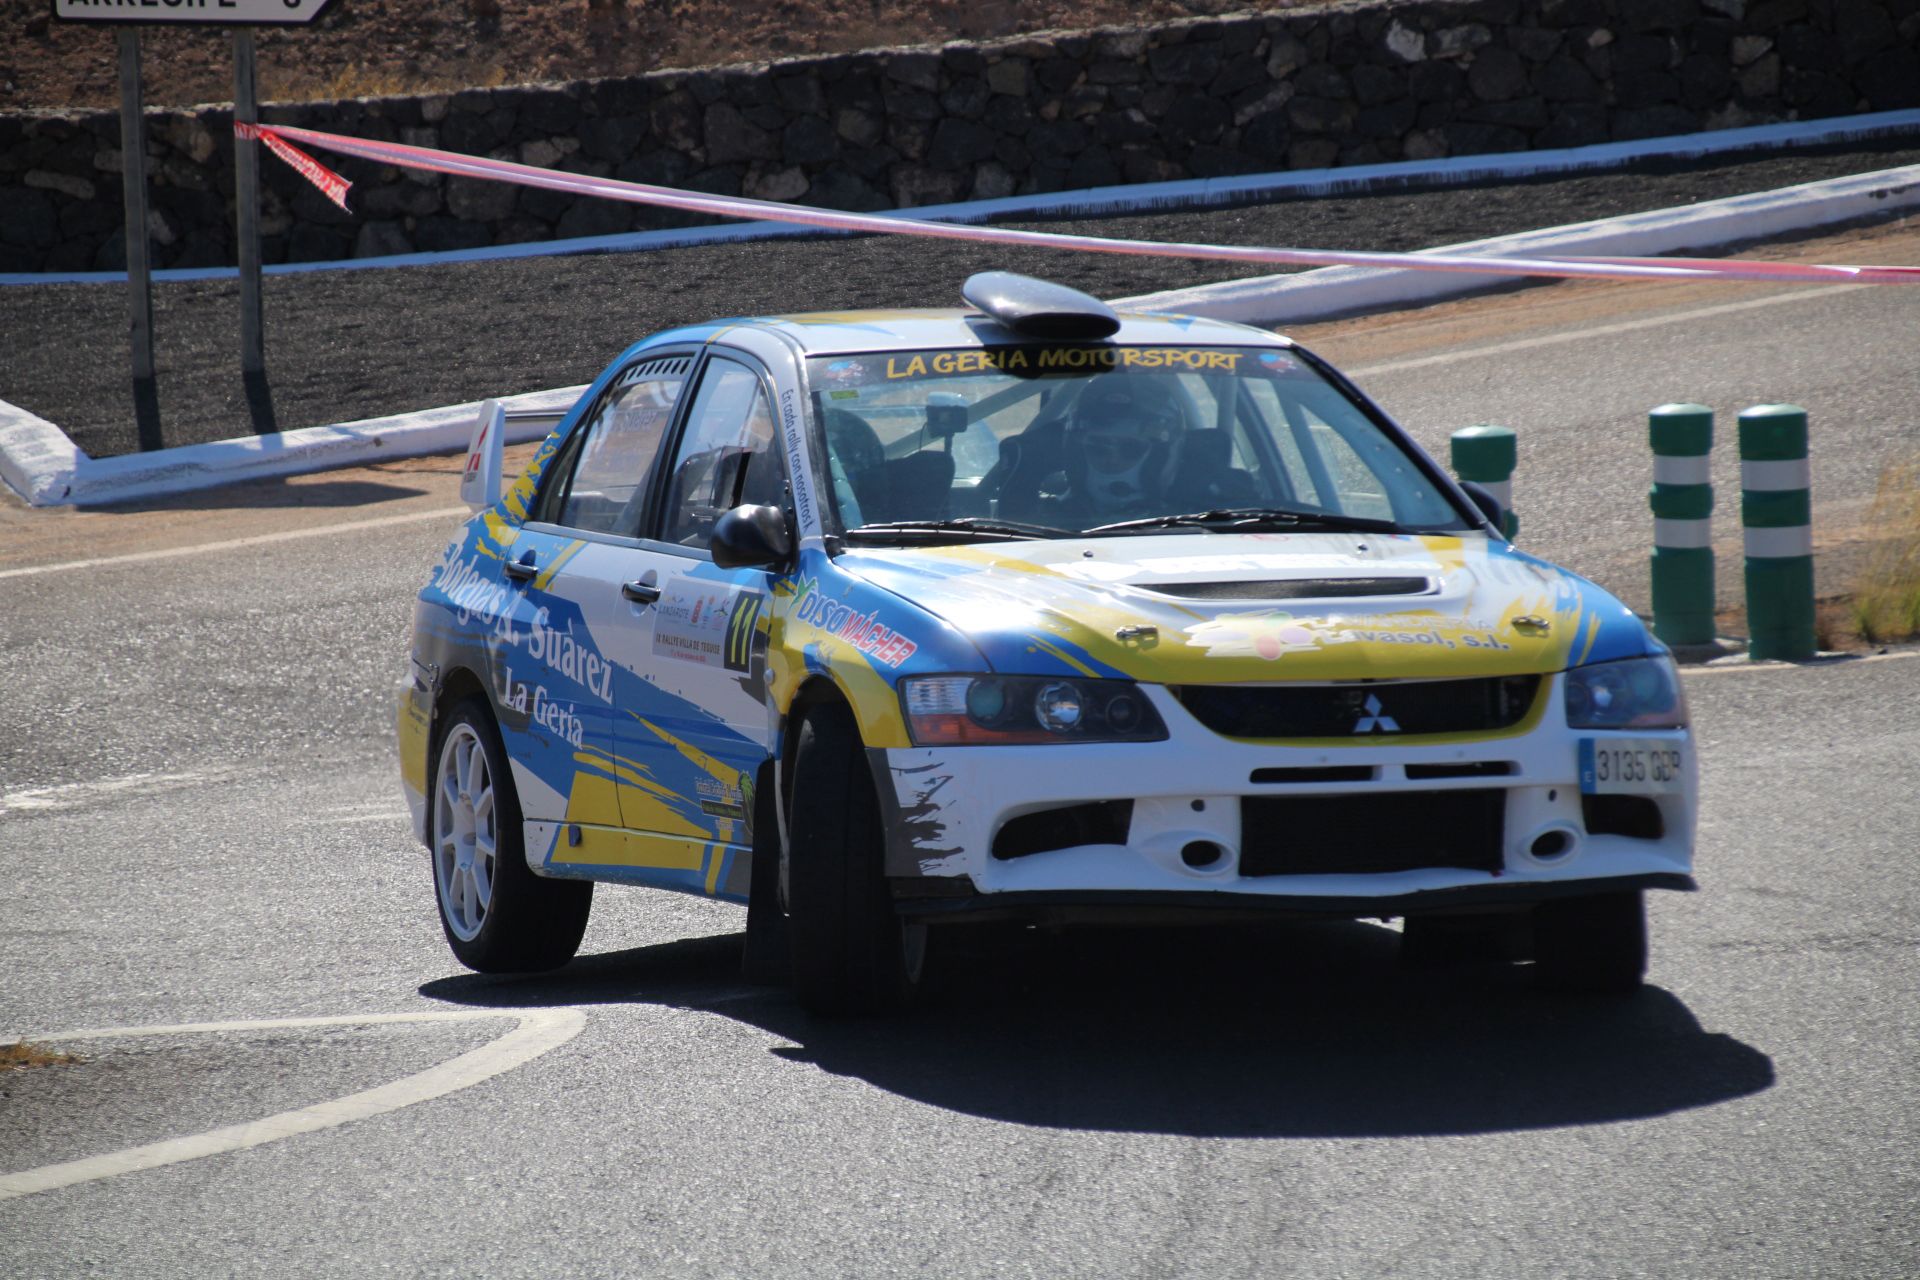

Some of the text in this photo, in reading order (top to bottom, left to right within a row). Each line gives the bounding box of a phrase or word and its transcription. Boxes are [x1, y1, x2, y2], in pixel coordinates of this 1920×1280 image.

[887, 348, 1244, 379] LA GERIA MOTORSPORT
[782, 388, 795, 401] En
[784, 401, 798, 428] cada
[787, 428, 802, 454] rally
[791, 453, 802, 474] con
[731, 597, 759, 665] 11
[504, 666, 584, 750] La Geria
[1597, 750, 1646, 781] 3135
